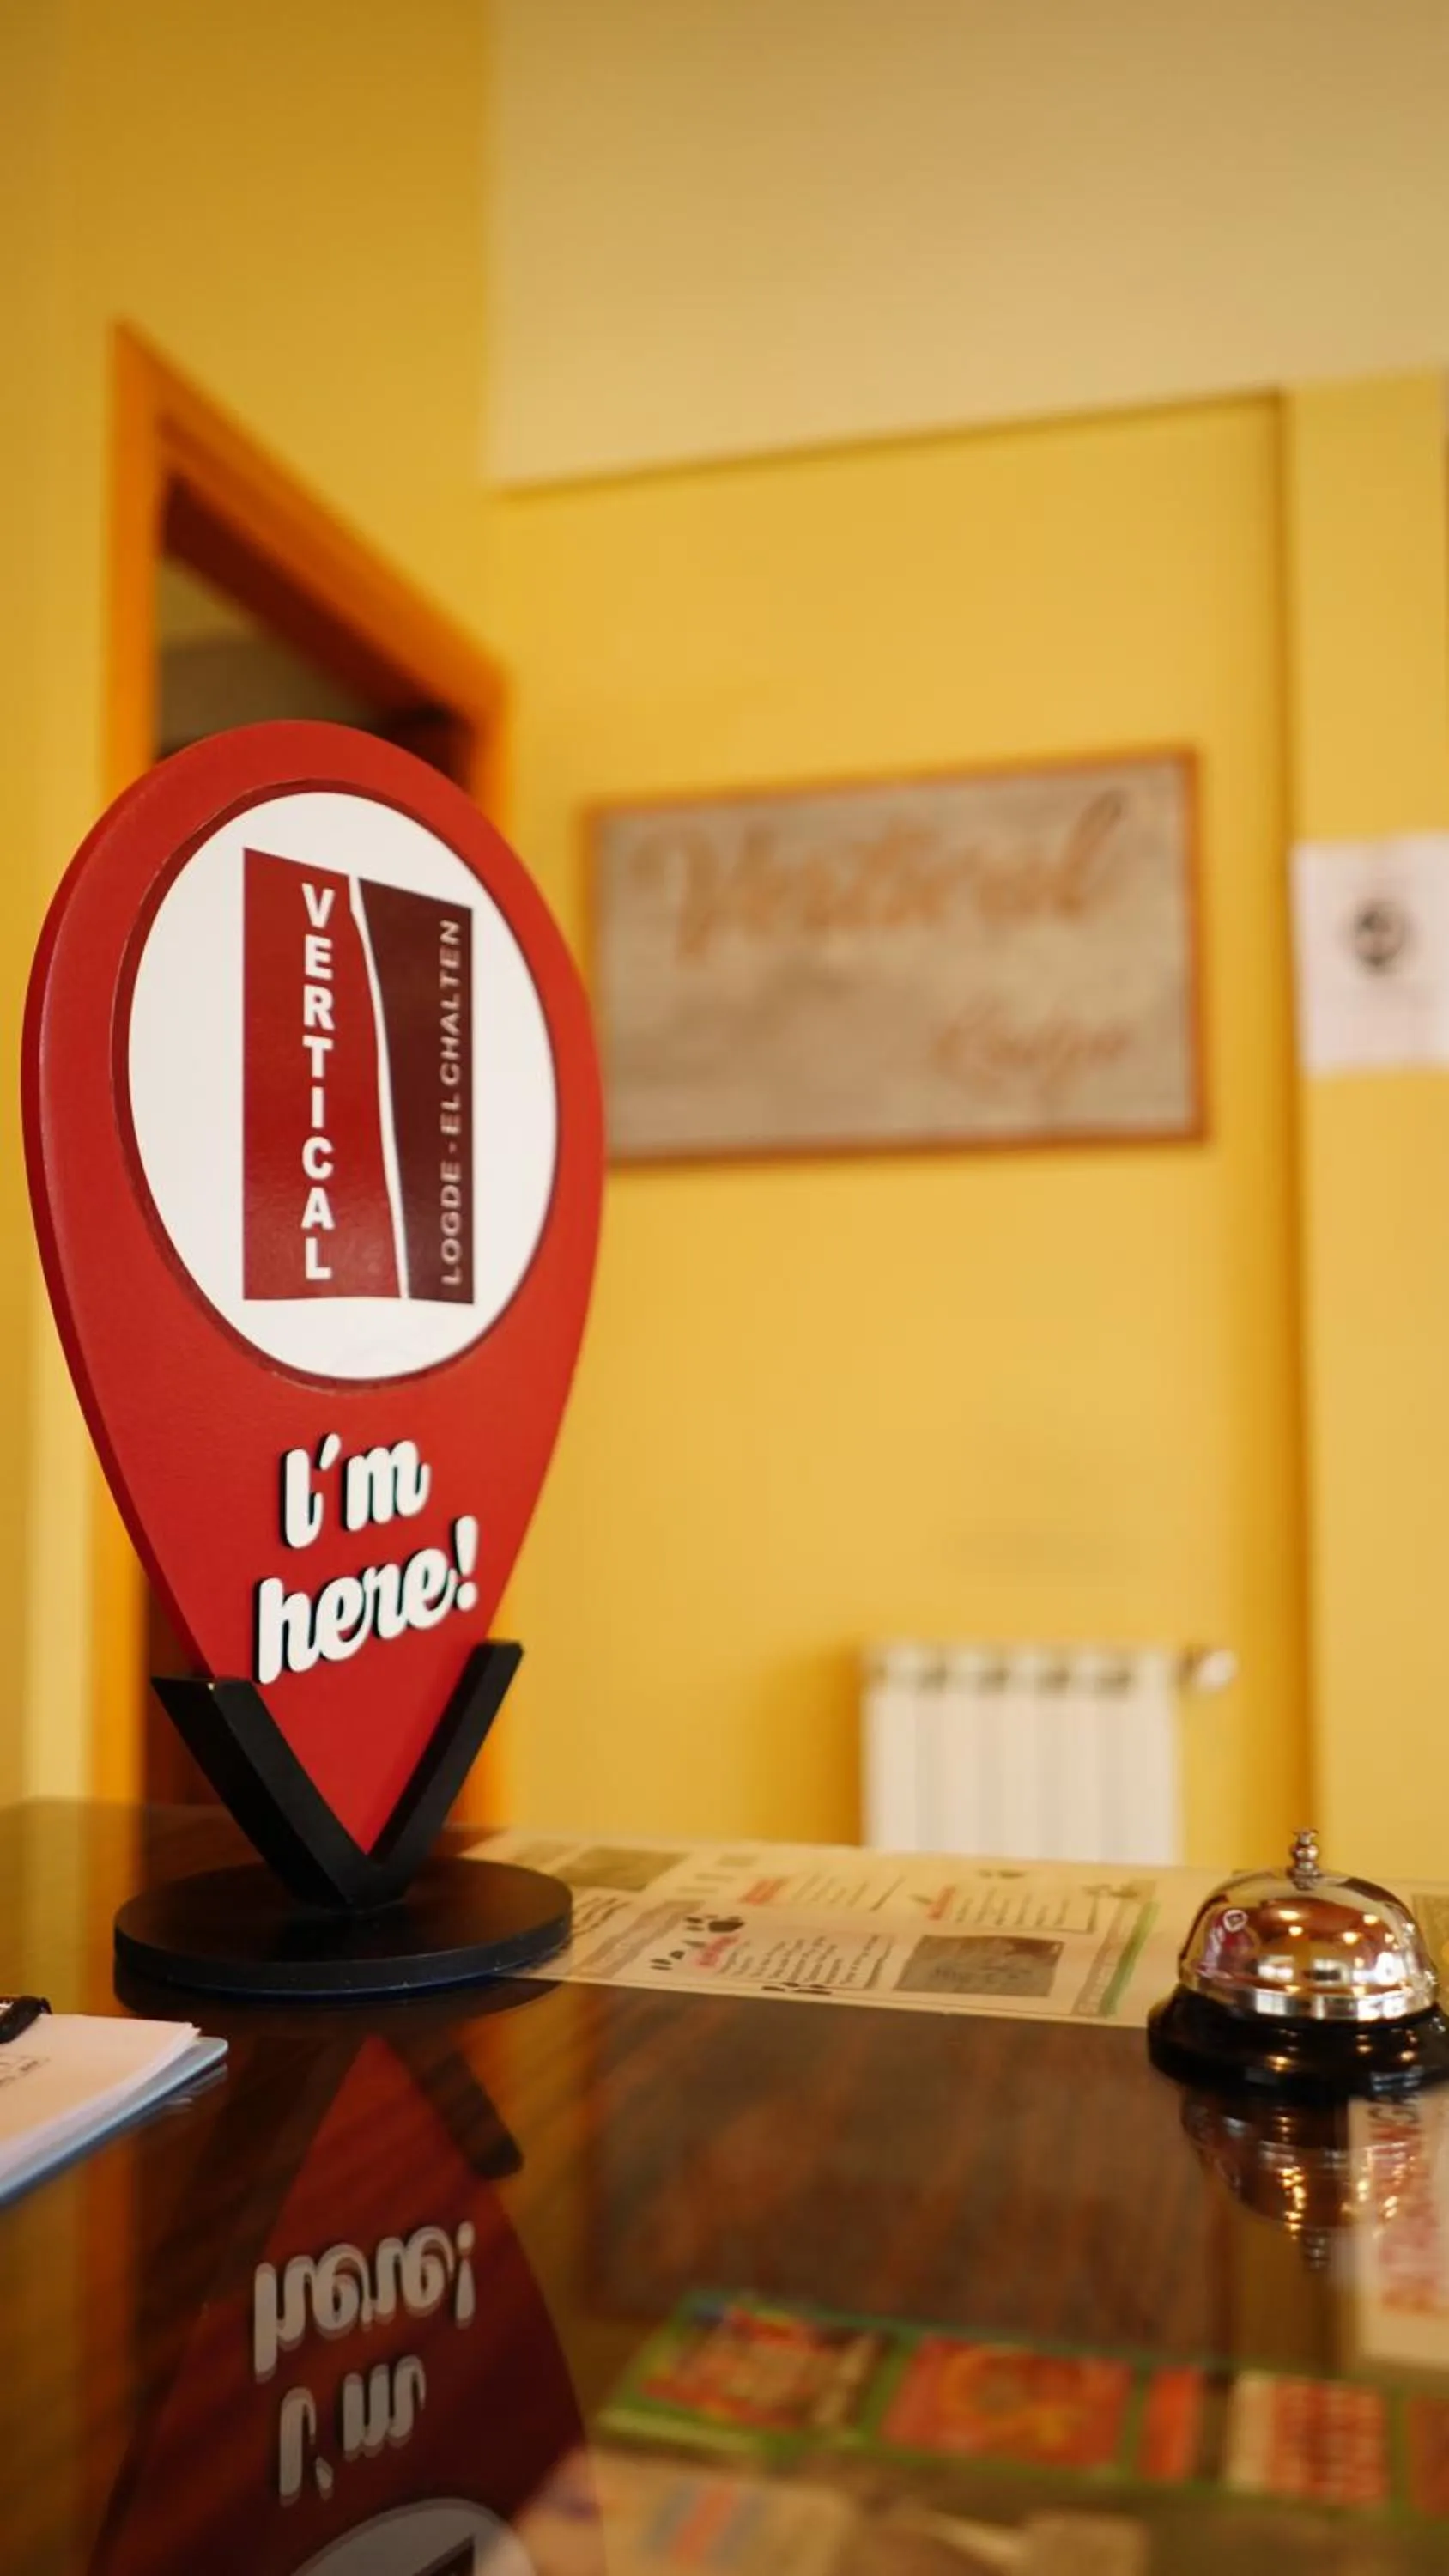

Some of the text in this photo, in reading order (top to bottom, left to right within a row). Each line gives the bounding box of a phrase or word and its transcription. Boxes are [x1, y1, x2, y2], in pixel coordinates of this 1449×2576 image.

[439, 920, 462, 1085] CHALTEN
[302, 883, 336, 1281] VERTICAL
[440, 1093, 462, 1135] EL
[440, 1160, 464, 1285] LOGDE
[284, 1432, 432, 1549] I'm
[258, 1515, 479, 1685] here!
